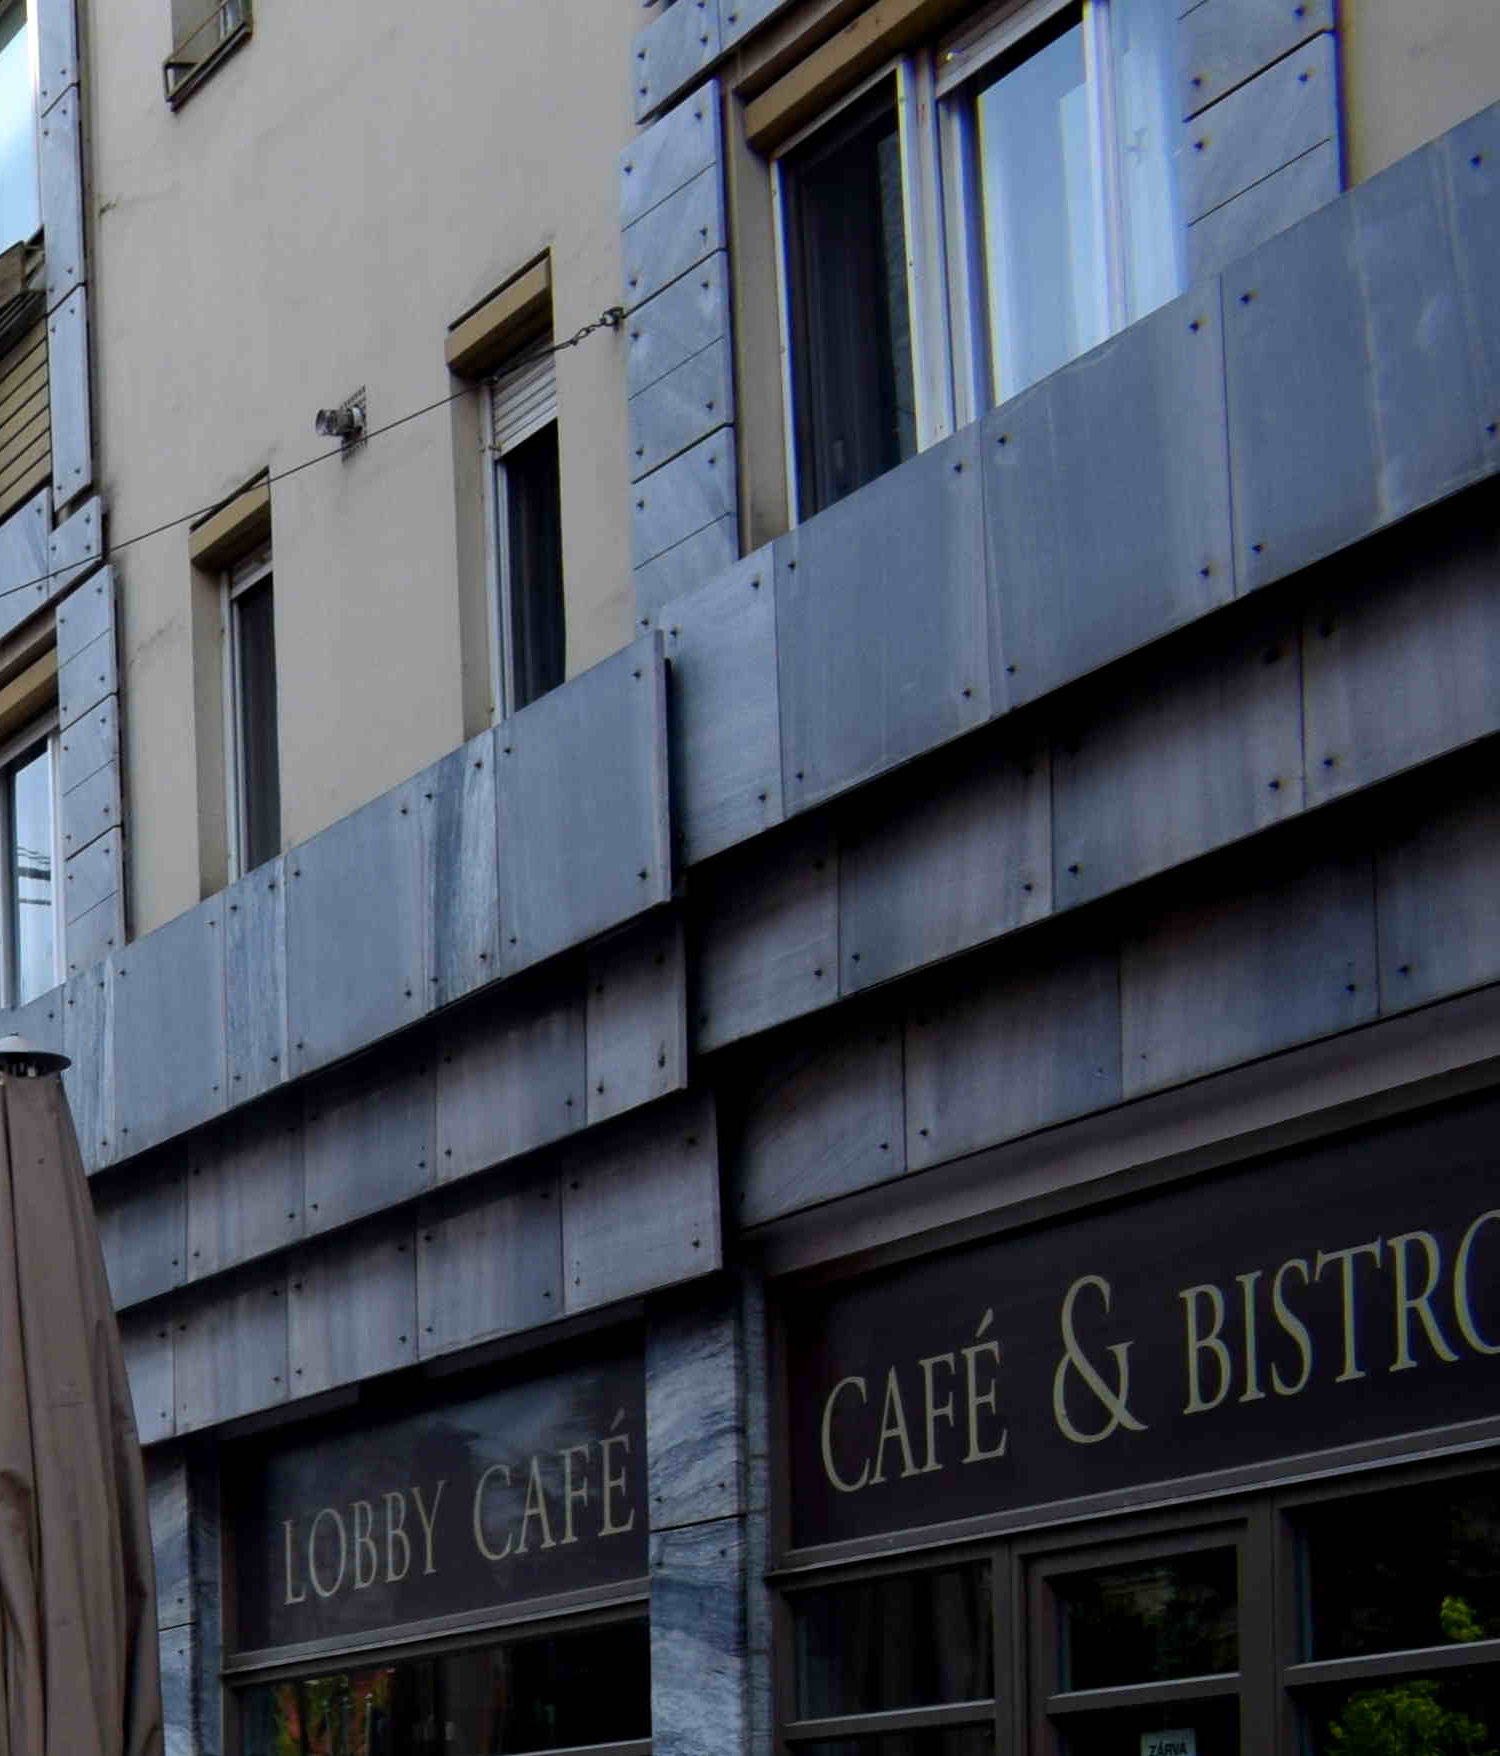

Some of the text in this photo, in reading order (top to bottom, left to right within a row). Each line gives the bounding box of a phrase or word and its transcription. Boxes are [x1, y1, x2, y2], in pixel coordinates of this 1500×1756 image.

[820, 1306, 1008, 1494] CAFÉ
[1052, 1274, 1149, 1445] &
[280, 1407, 636, 1606] LOBBY CAFÉ
